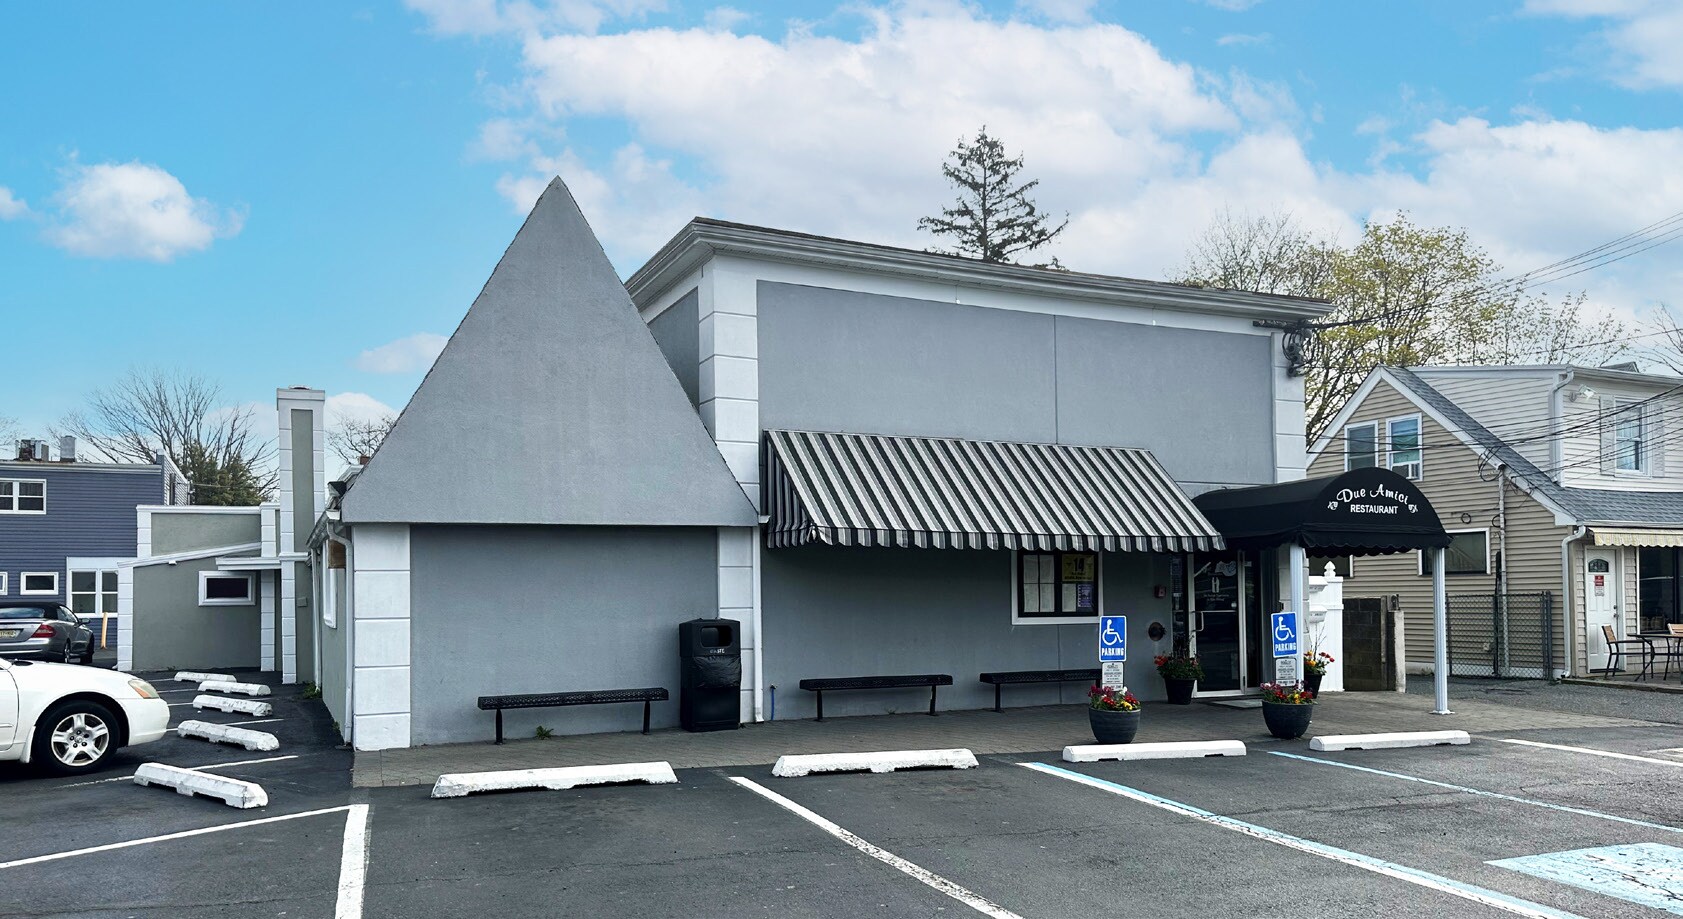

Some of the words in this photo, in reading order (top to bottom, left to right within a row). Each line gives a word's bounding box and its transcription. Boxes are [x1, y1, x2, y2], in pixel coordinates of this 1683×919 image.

[1336, 488, 1366, 503] Due
[1369, 483, 1409, 505] Amici
[1350, 504, 1399, 514] RESTAURANT
[1101, 647, 1125, 656] PARKING
[1275, 642, 1297, 652] PARKING
